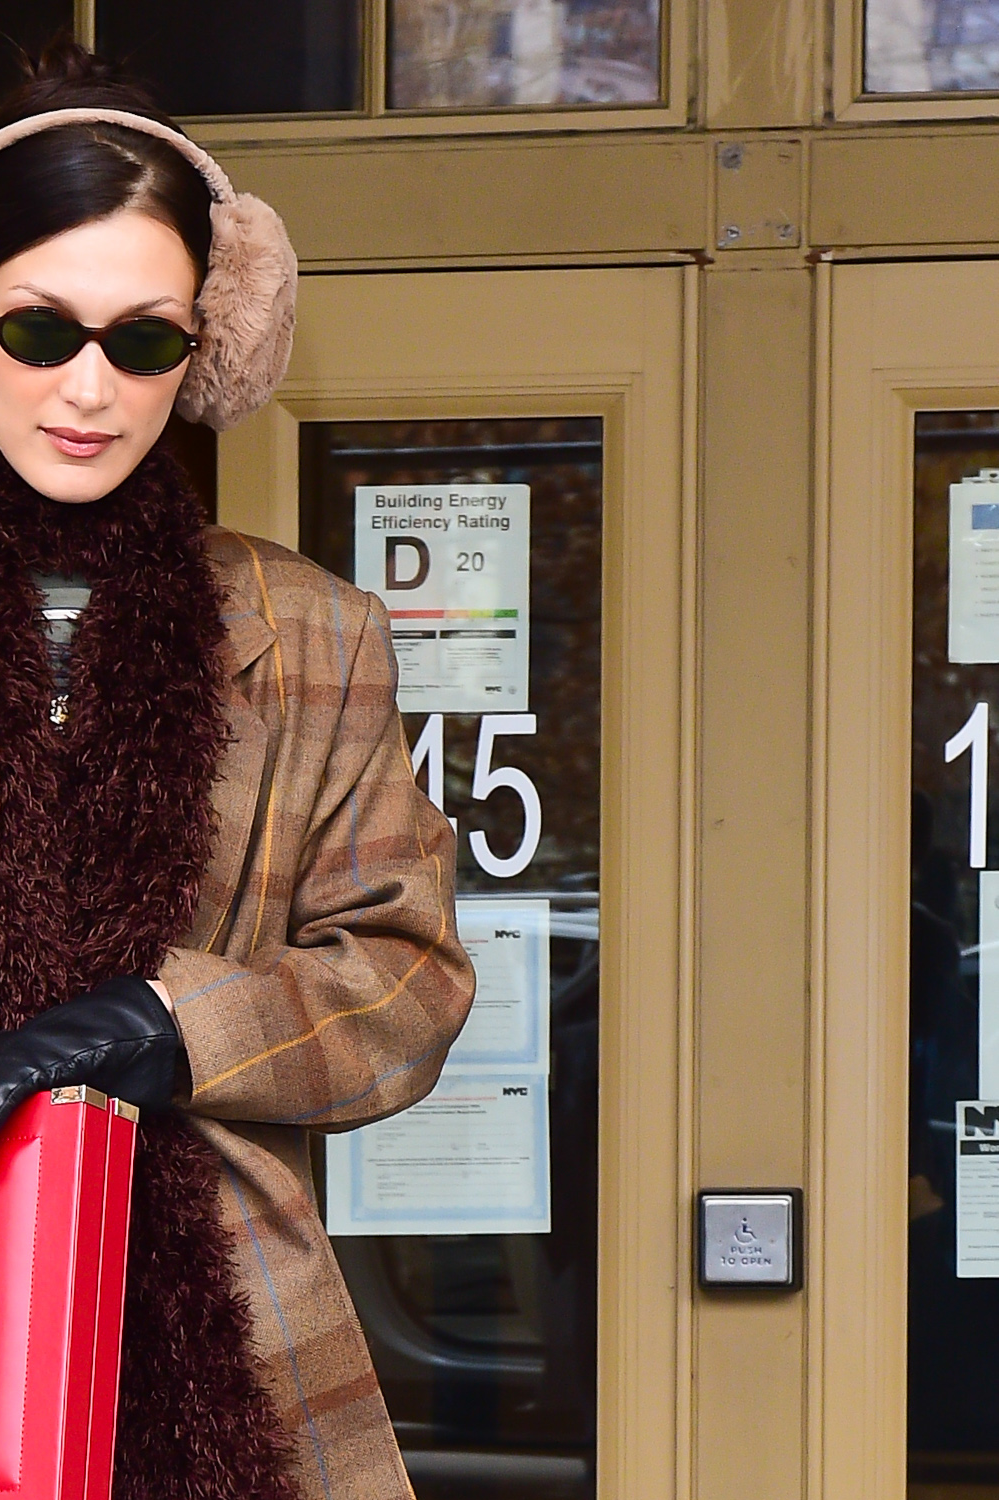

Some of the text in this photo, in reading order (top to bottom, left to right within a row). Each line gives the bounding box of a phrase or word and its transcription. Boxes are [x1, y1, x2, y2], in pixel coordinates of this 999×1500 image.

[375, 493, 507, 511] Building Energy
[371, 514, 511, 532] Efficiency Rating
[385, 535, 430, 591] D
[456, 551, 485, 572] 20
[945, 702, 989, 868] 1
[494, 929, 521, 939] NYC
[502, 1086, 528, 1096] NYC
[730, 1246, 763, 1255] PUSH
[721, 1256, 772, 1266] TO OPEN
